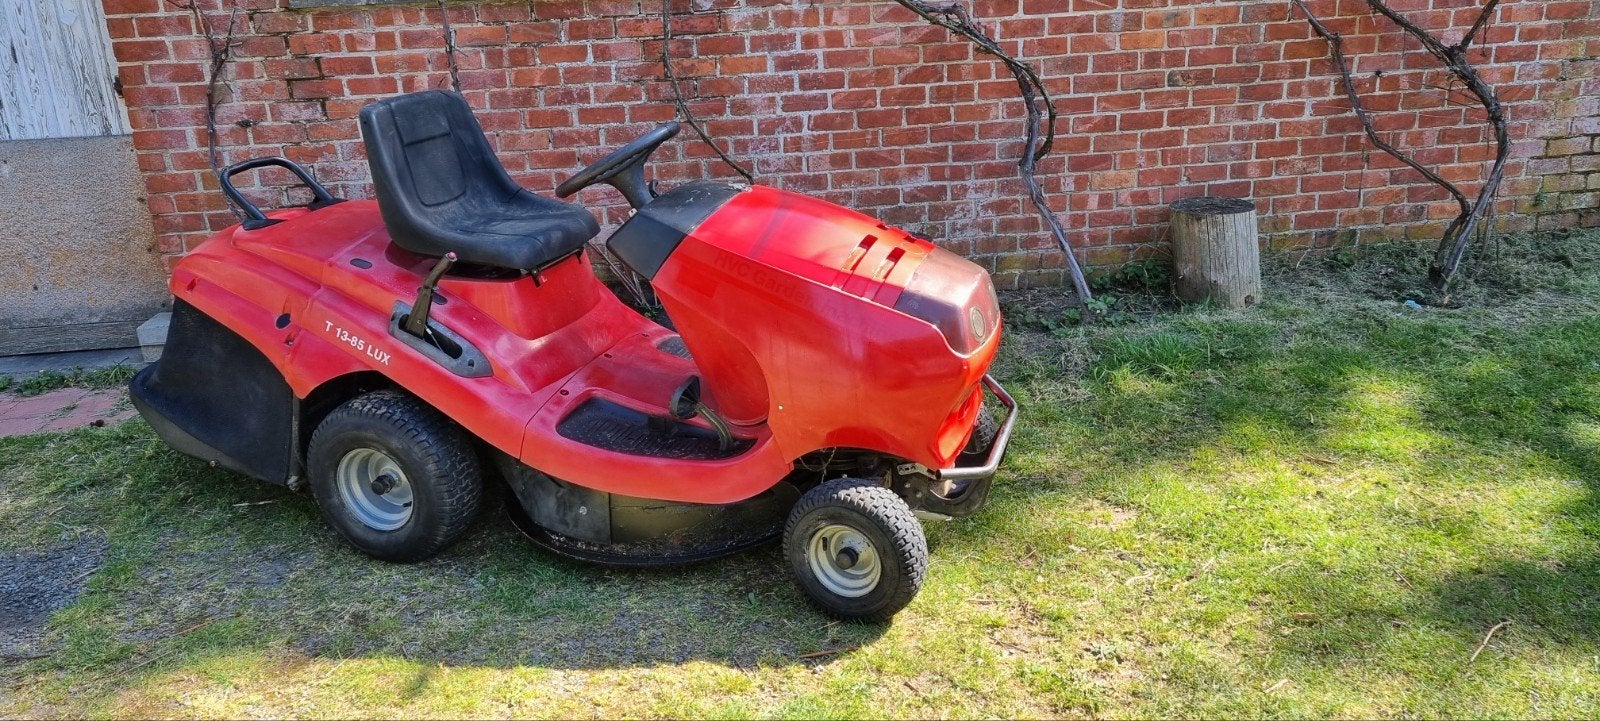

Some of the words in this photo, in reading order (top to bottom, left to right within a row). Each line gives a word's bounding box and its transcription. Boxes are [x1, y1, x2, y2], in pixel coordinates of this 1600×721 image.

[713, 251, 750, 277] HVC
[325, 320, 333, 332] T
[336, 327, 365, 351] 13-85
[366, 344, 391, 365] LUX
